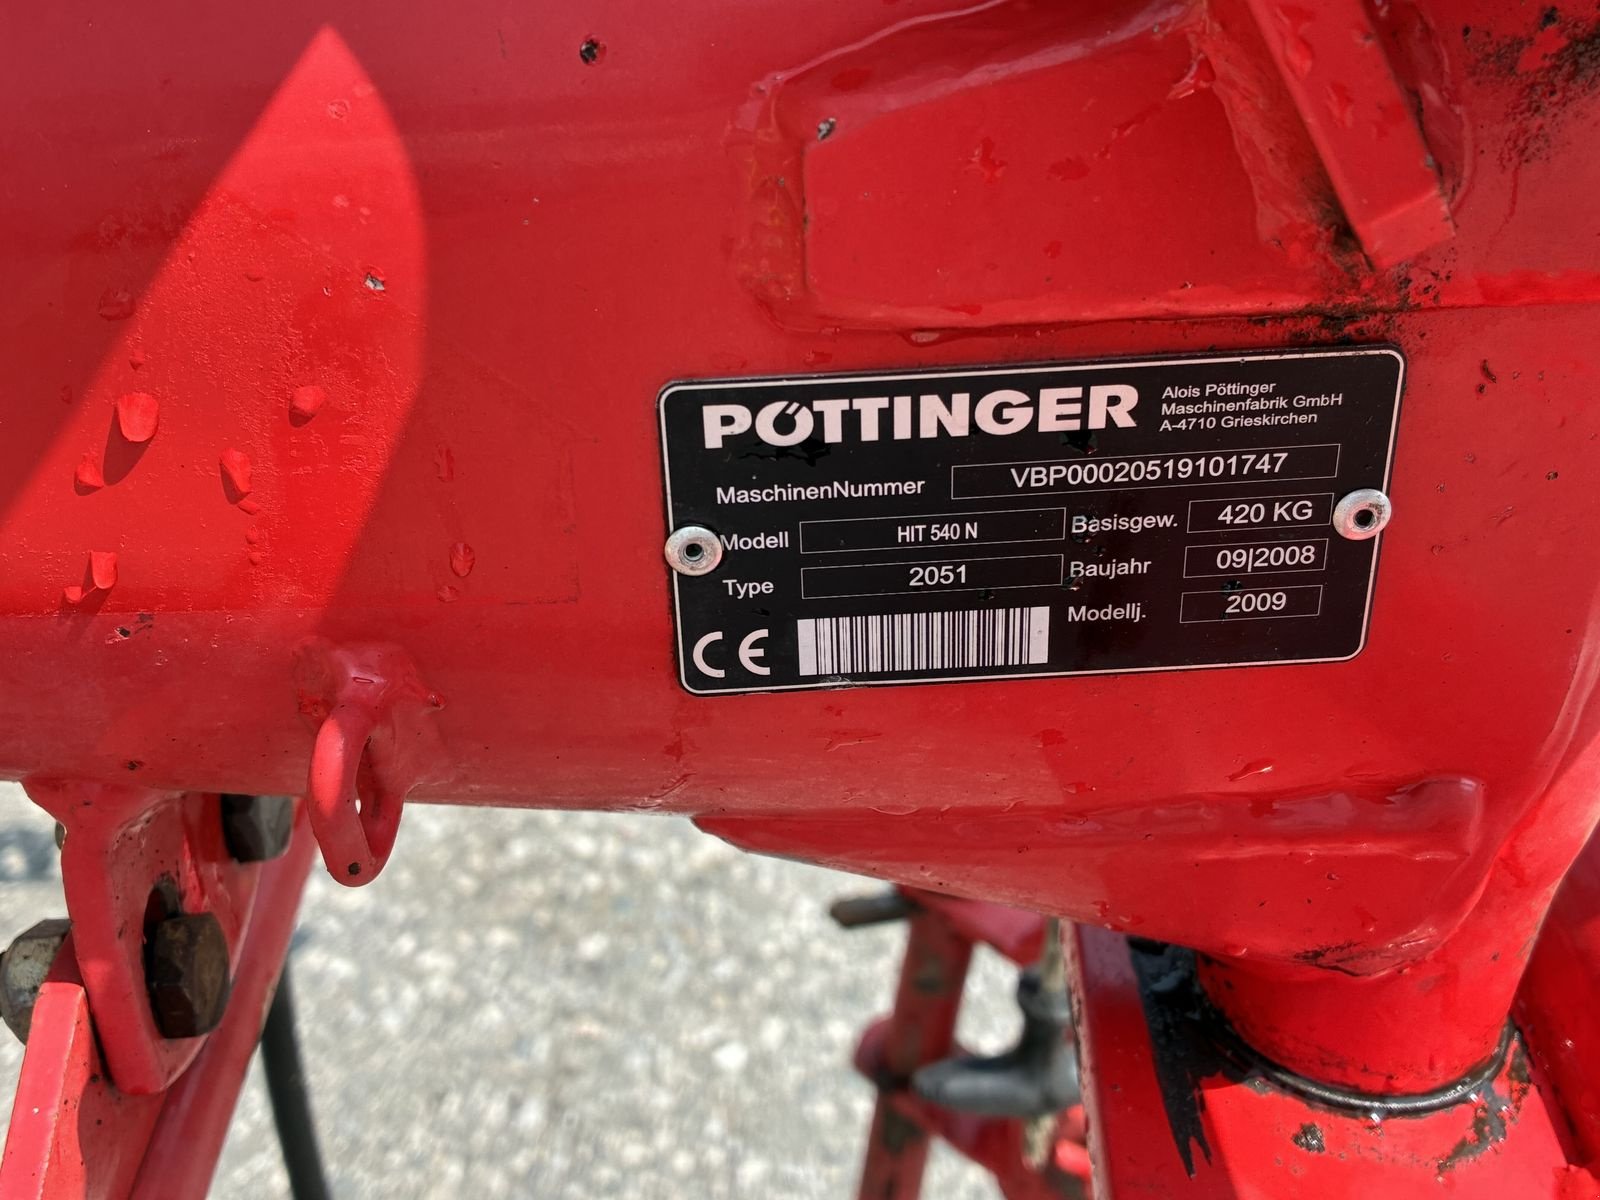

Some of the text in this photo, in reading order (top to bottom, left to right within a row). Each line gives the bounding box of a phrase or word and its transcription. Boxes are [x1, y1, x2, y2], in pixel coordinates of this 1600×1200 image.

[1162, 381, 1276, 399] Alois Pöttinger
[1161, 393, 1343, 416] Maschinenfabrik GmbH
[702, 384, 1139, 449] PÖTTINGER
[1159, 412, 1318, 432] A-4710 Grieskirchen
[1010, 452, 1288, 489] VBP00020519101747
[716, 479, 925, 504] MaschinenNummer
[1071, 512, 1178, 534] Basisgew.
[1217, 500, 1313, 524] 420 KG
[720, 532, 789, 551] Modell
[898, 522, 978, 543] HIT 540 N
[1070, 557, 1152, 579] Baujahr
[1216, 545, 1315, 572] 09|2008
[909, 565, 967, 586] 2051
[722, 579, 774, 599] Type
[1067, 603, 1146, 623] Modellj.
[1225, 591, 1287, 614] 2009
[693, 628, 771, 678] CE
